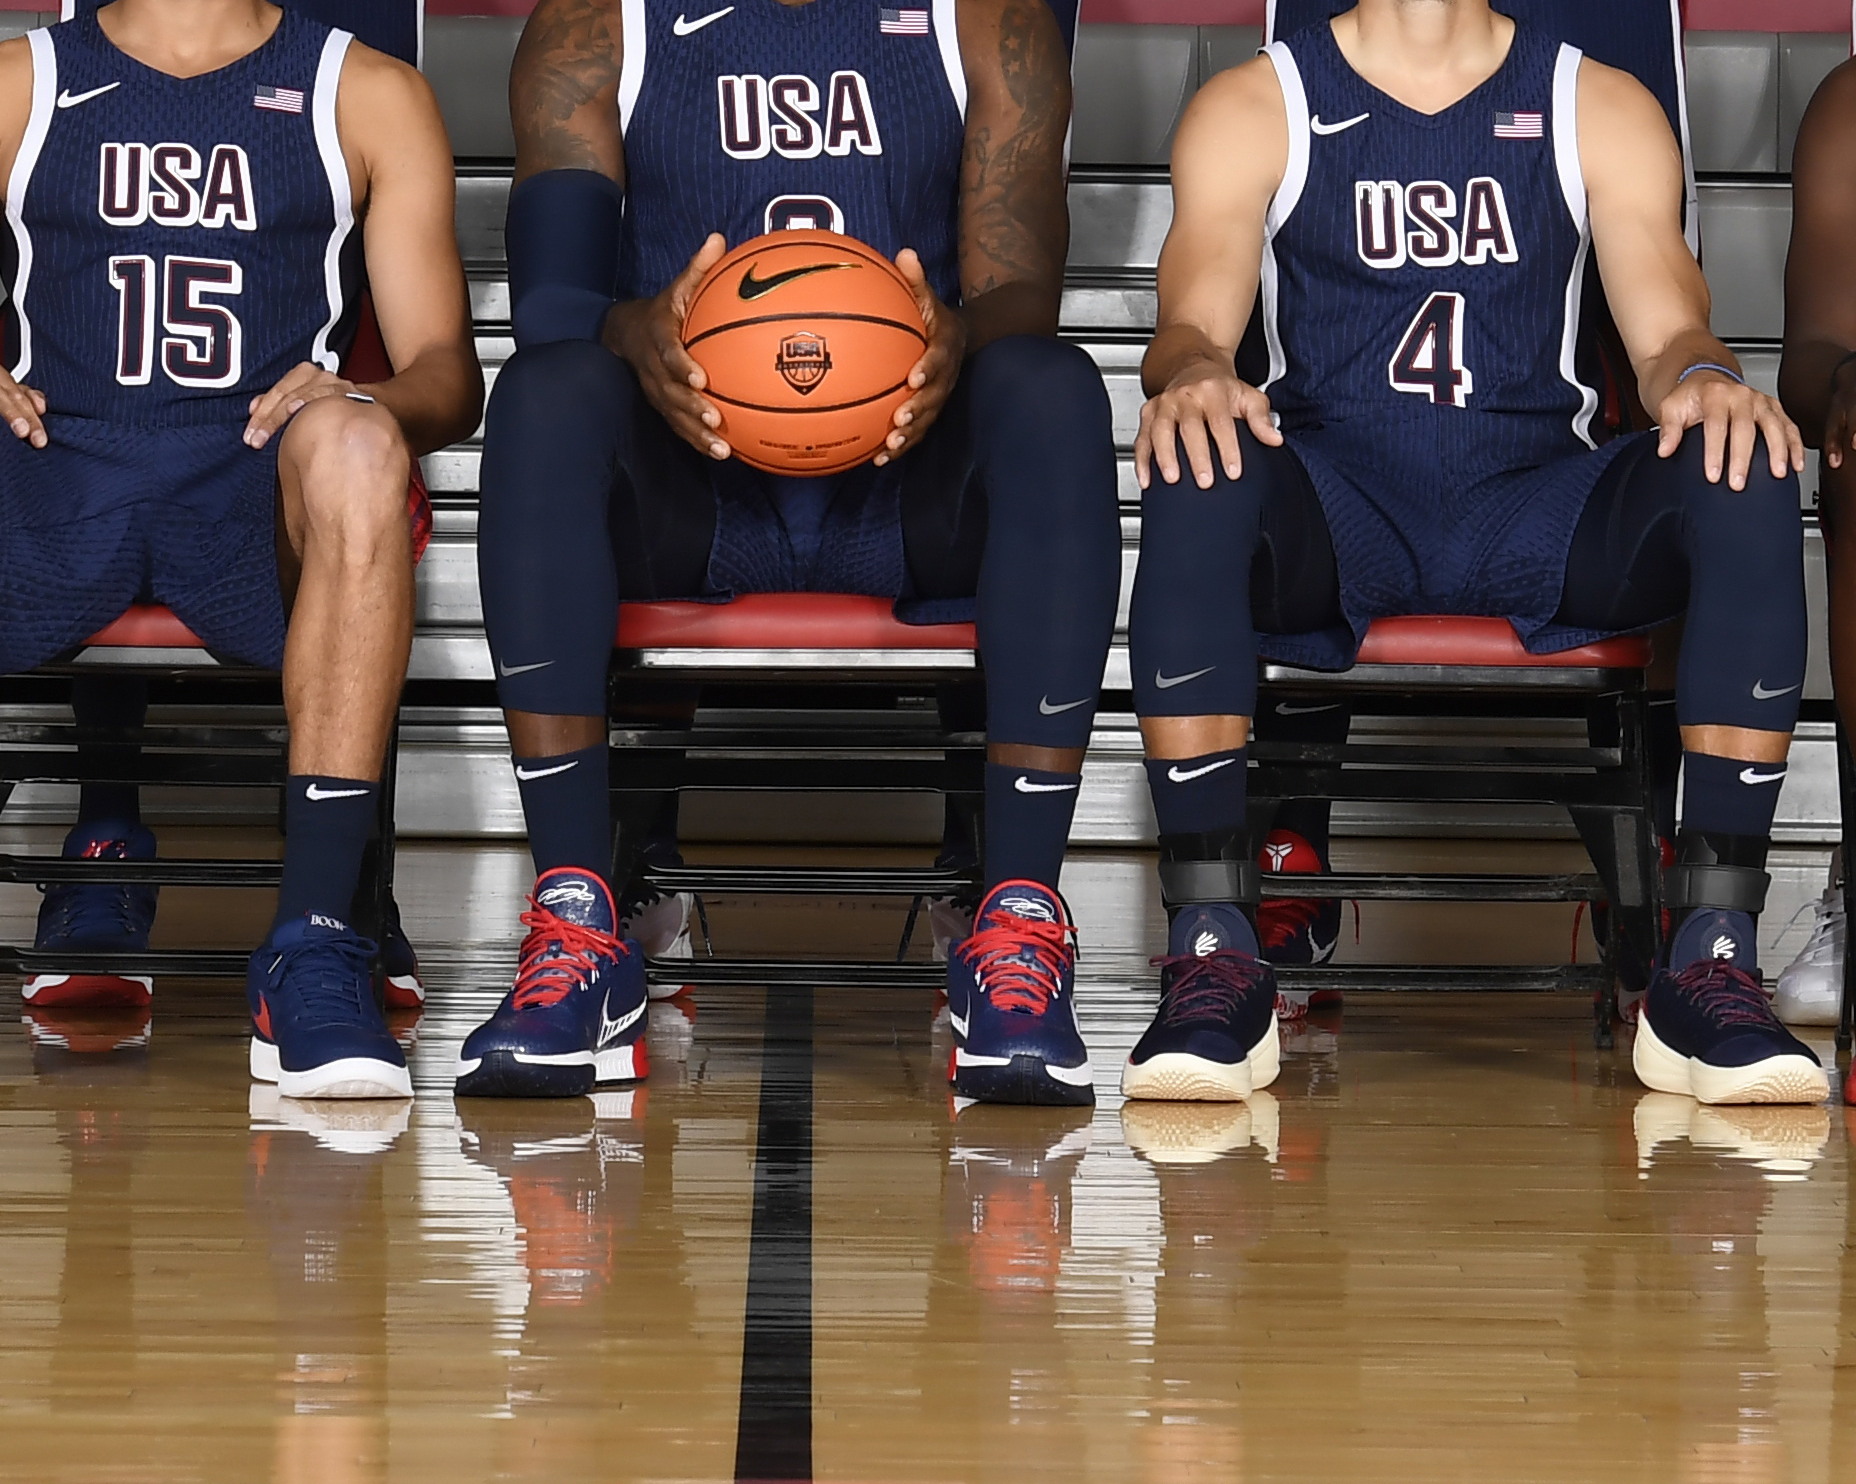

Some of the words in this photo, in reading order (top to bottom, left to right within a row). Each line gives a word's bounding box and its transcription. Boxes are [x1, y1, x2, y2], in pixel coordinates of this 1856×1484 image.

[717, 70, 883, 160] USA
[98, 142, 257, 231] USA
[1354, 176, 1519, 269] USA
[108, 254, 243, 389] 15
[1388, 291, 1474, 409] 4
